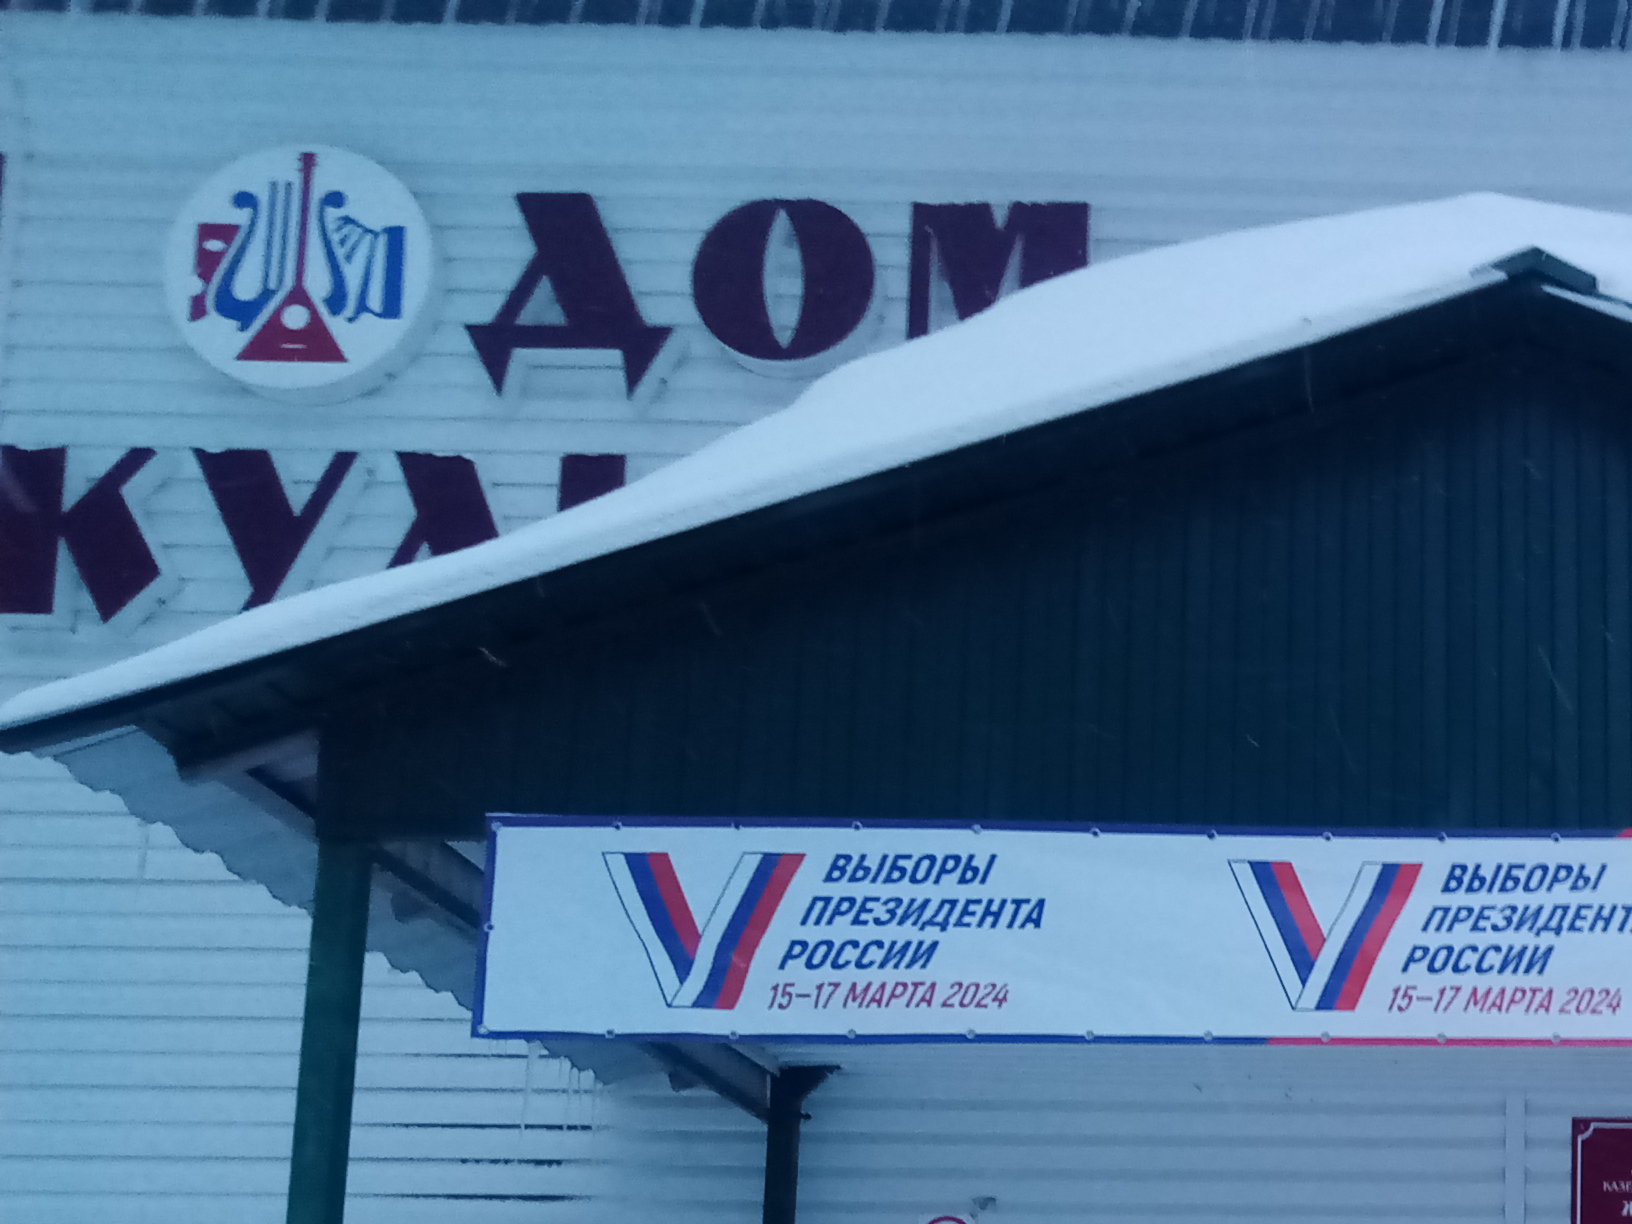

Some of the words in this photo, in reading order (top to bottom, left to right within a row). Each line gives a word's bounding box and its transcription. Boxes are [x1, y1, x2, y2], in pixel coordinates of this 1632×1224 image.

[465, 192, 1091, 398] ДОМ
[822, 853, 998, 886] ВЫБОРЫ
[1440, 862, 1607, 894] ВЫБОРЫ
[799, 896, 1046, 932] ПРЕЗИДЕНТА
[778, 939, 939, 971] РОССИИ
[1401, 944, 1555, 975] РОССИИ
[842, 982, 934, 1010] МАРТА
[940, 982, 1010, 1010] 2024
[1462, 986, 1554, 1014] МАРТА
[1558, 987, 1623, 1015] 2024
